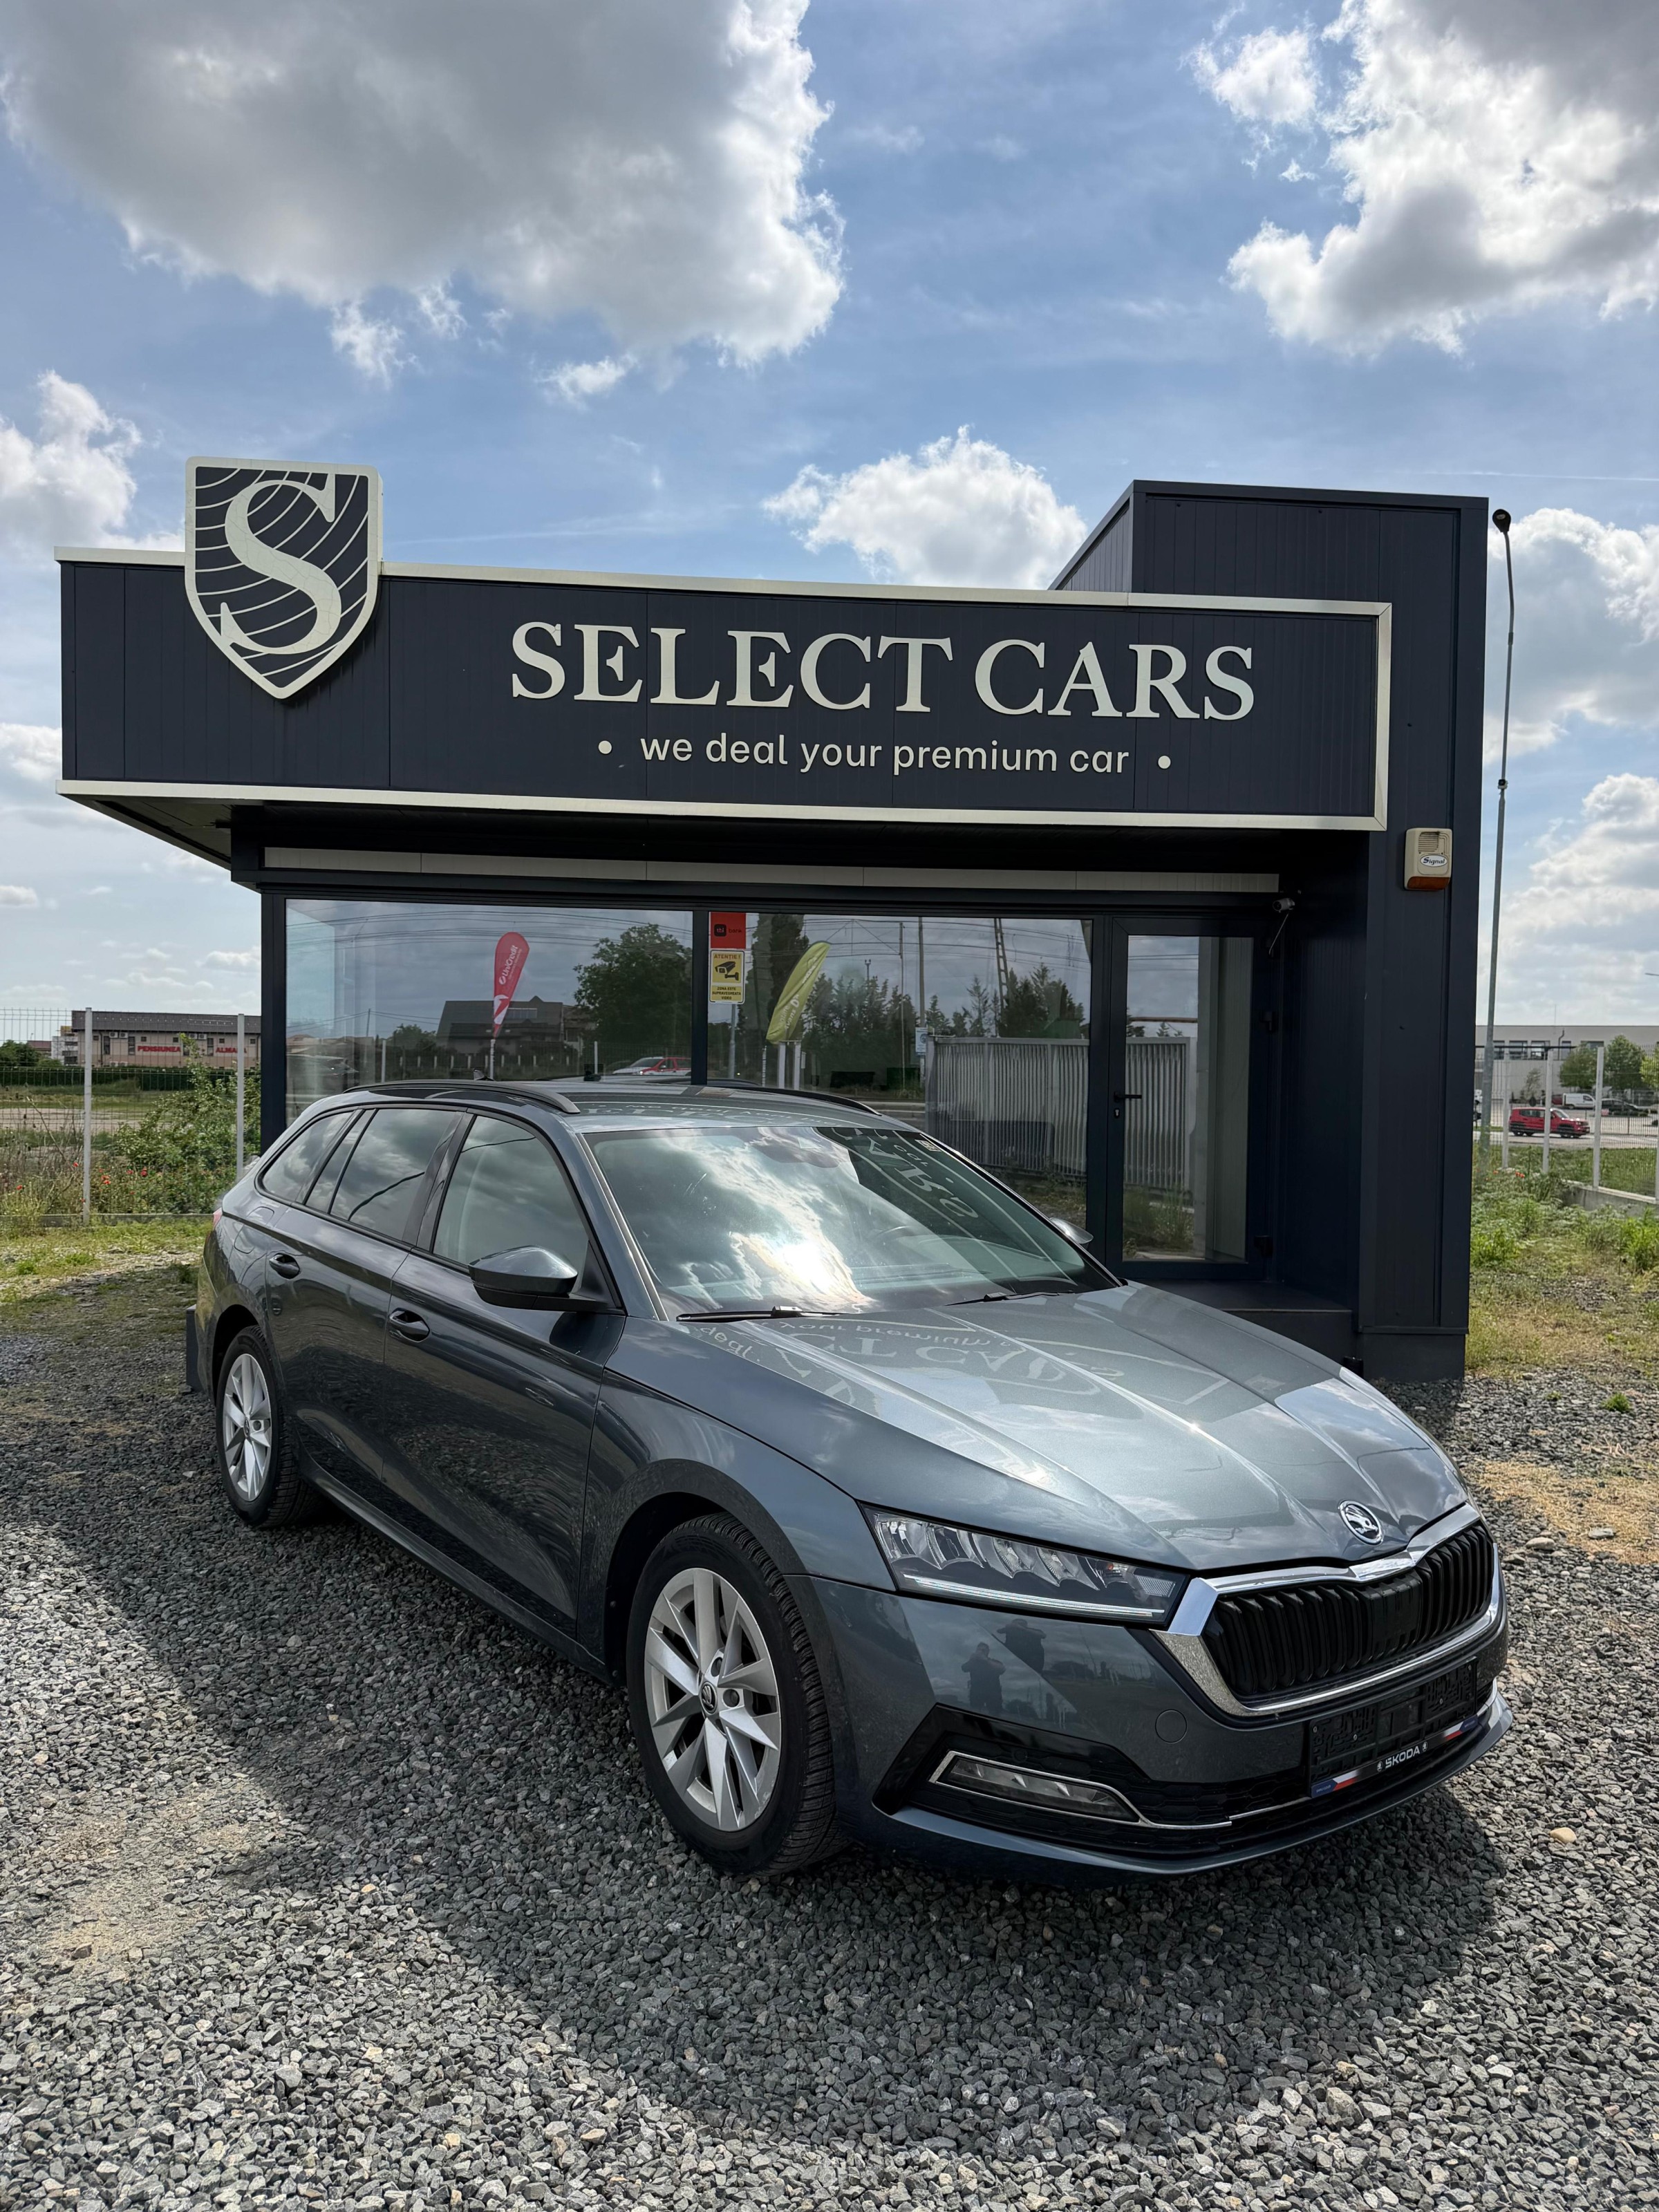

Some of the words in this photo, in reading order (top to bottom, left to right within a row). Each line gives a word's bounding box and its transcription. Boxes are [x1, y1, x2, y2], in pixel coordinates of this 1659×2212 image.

[512, 621, 953, 713] SELECT
[975, 639, 1254, 720] CARS
[640, 738, 693, 761] we
[706, 732, 788, 765] deal
[800, 743, 882, 773] your
[894, 740, 1057, 776] premium
[1070, 750, 1130, 773] car
[1423, 856, 1445, 865] Signal
[502, 945, 518, 977] UniCredit
